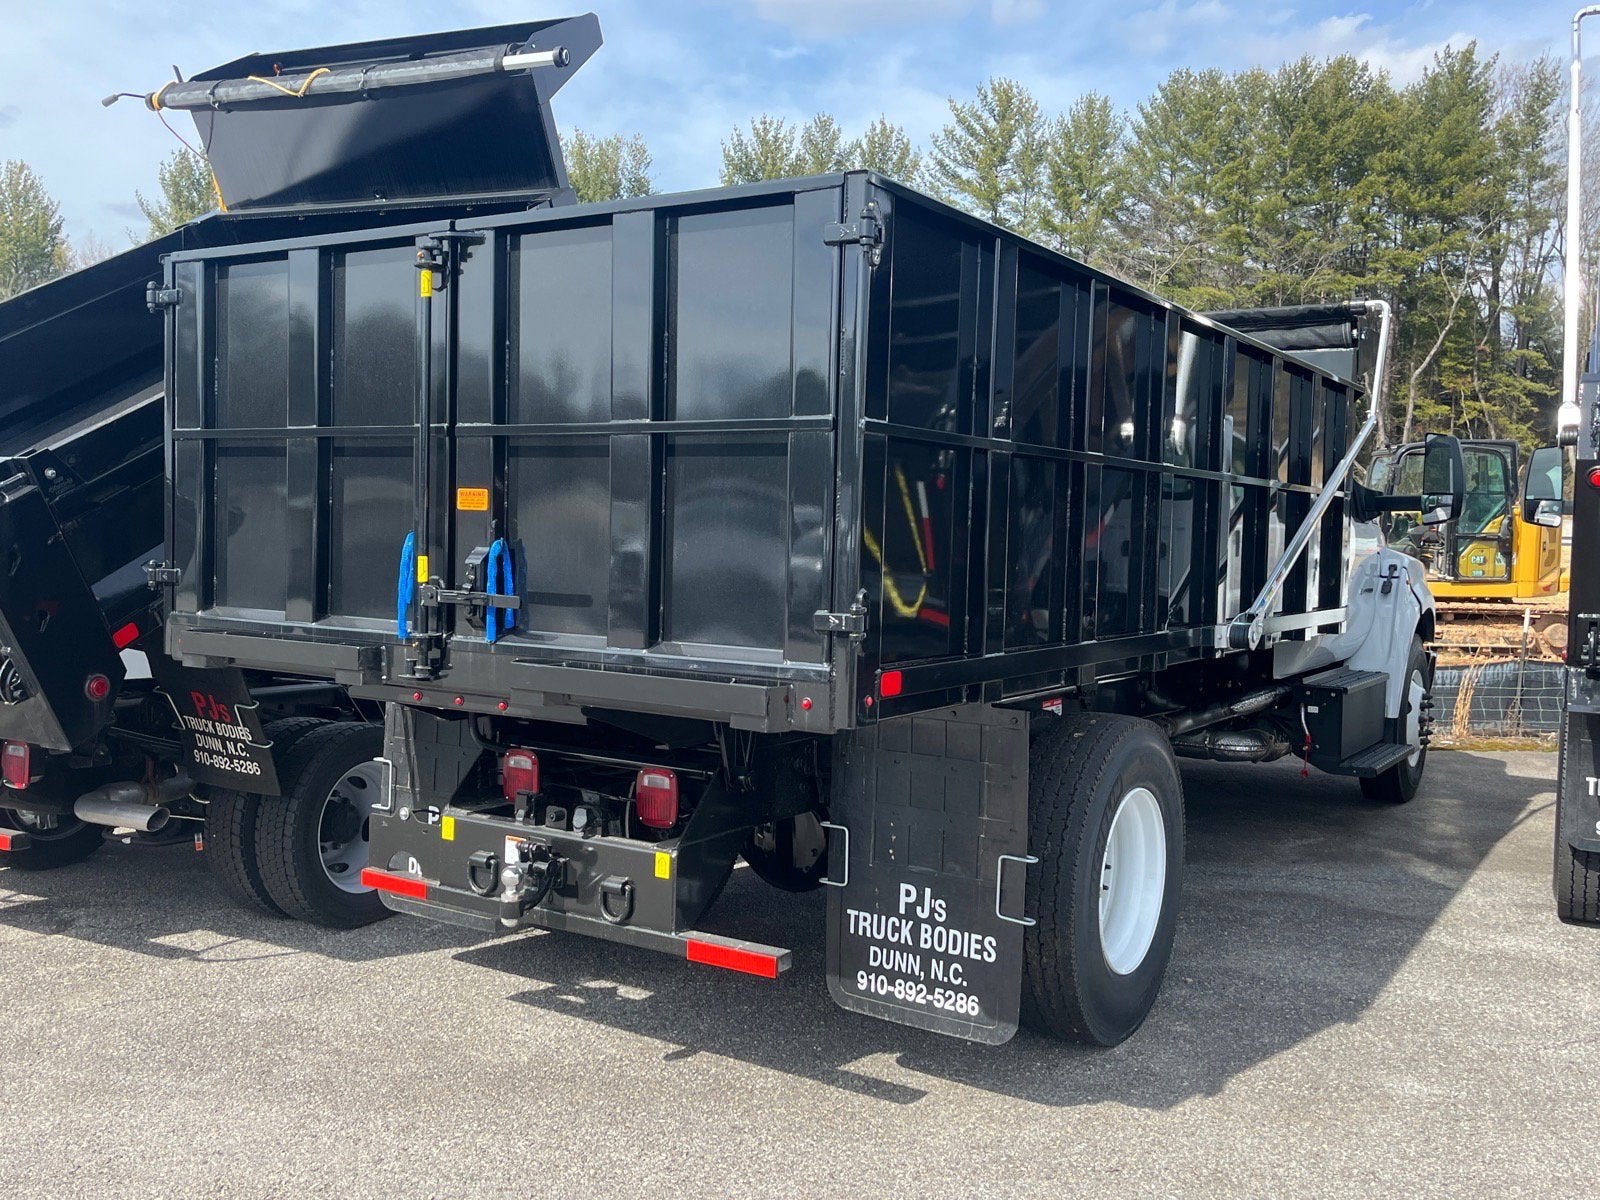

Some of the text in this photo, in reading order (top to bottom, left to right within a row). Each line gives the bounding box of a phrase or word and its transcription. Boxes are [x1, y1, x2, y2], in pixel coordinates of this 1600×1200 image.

[1471, 556, 1484, 564] CAT
[183, 715, 252, 741] TRUCK BODIES
[195, 734, 250, 757] DUNN, N.C.
[194, 749, 261, 775] 910-892-5286
[899, 883, 947, 922] PJ's
[847, 908, 997, 963] TRUCK BODIES
[869, 945, 968, 987] DUNN, N.C.
[857, 970, 979, 1016] 910-892-5286
